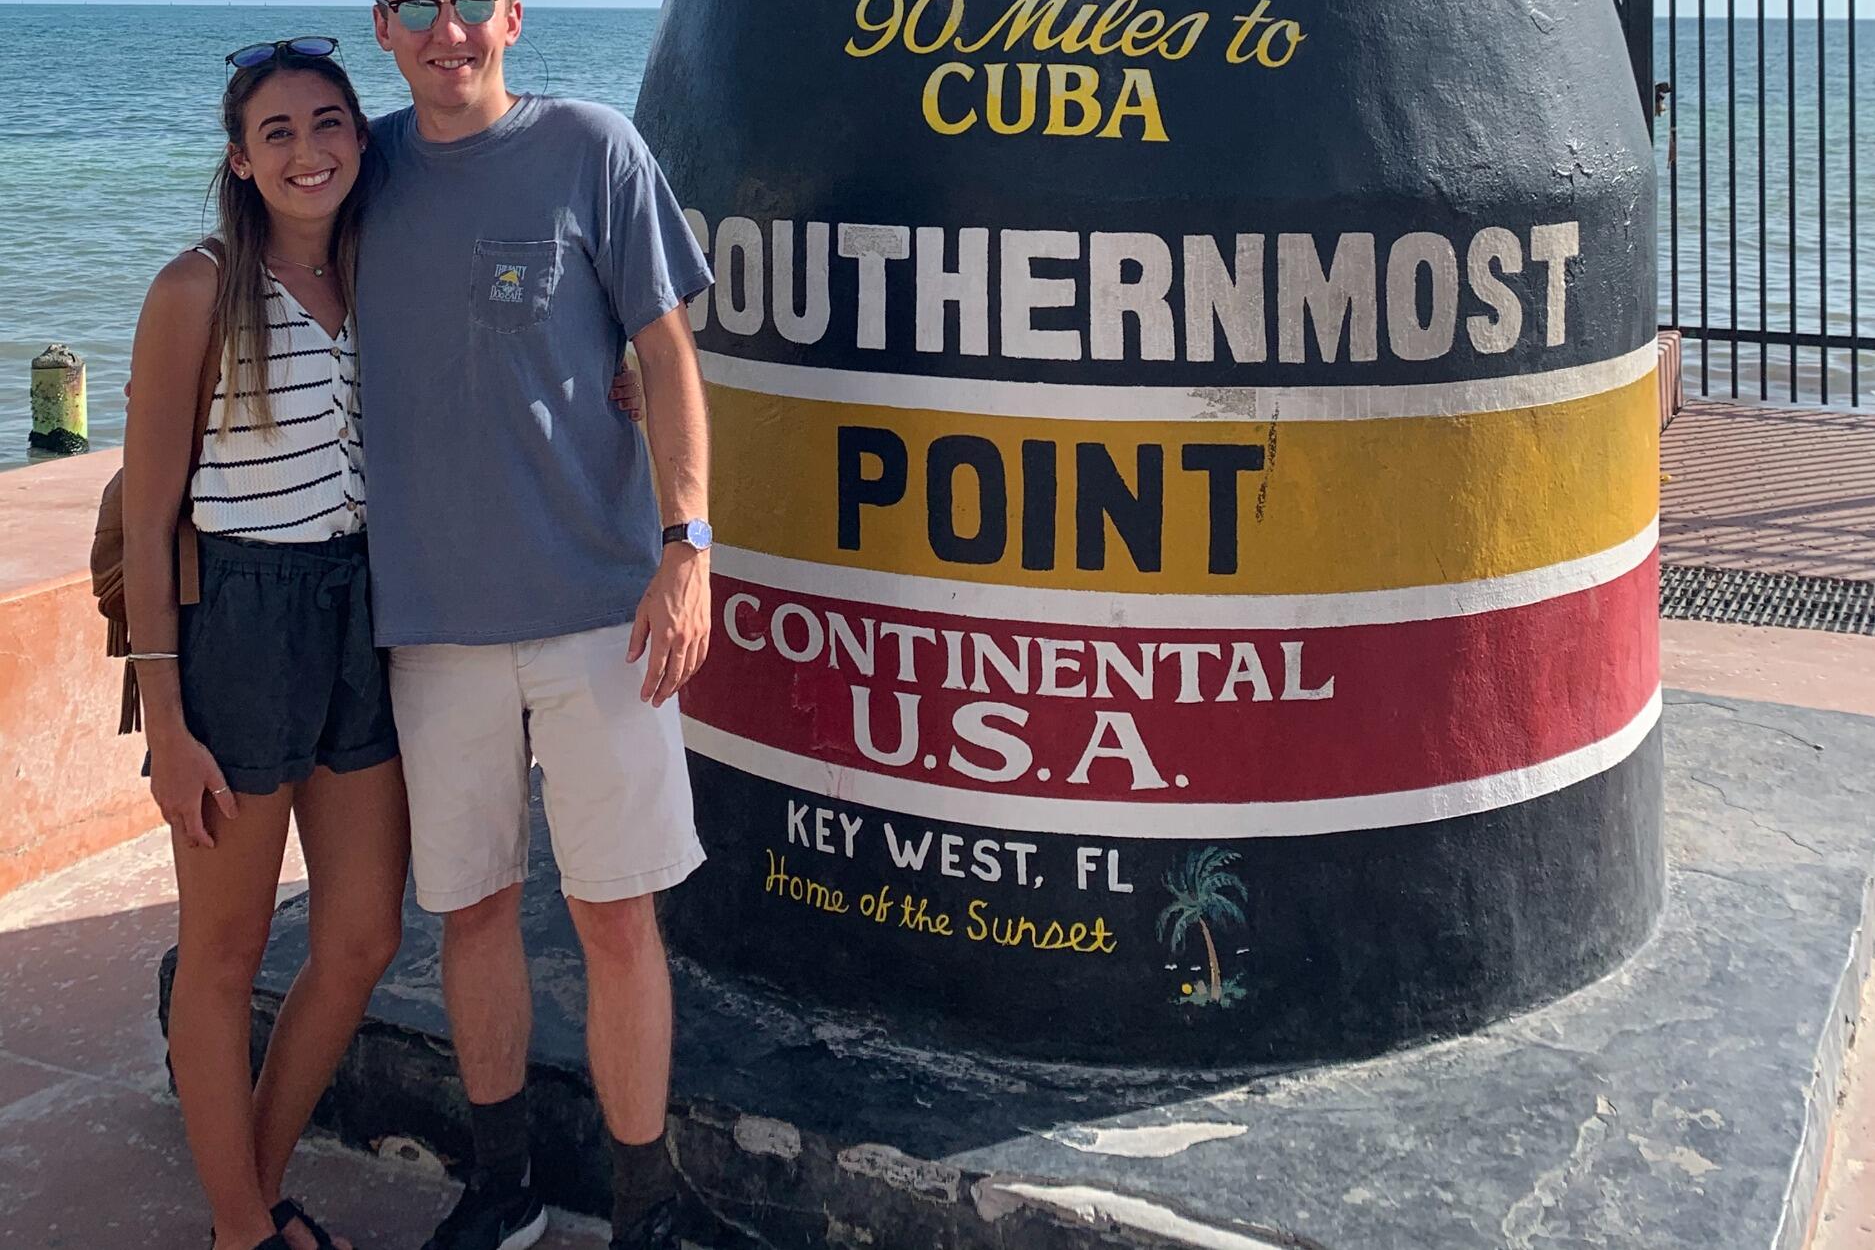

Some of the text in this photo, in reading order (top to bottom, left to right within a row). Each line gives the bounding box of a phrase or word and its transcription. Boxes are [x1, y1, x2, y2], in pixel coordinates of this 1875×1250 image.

[922, 61, 1171, 143] CUBA
[837, 425, 1265, 576] POINT
[723, 591, 1336, 704] CONTINENTAL
[850, 685, 1191, 792] U.S.A.
[786, 799, 1135, 895] KEY WEST, FL
[765, 848, 1120, 955] Home of the Sunset
